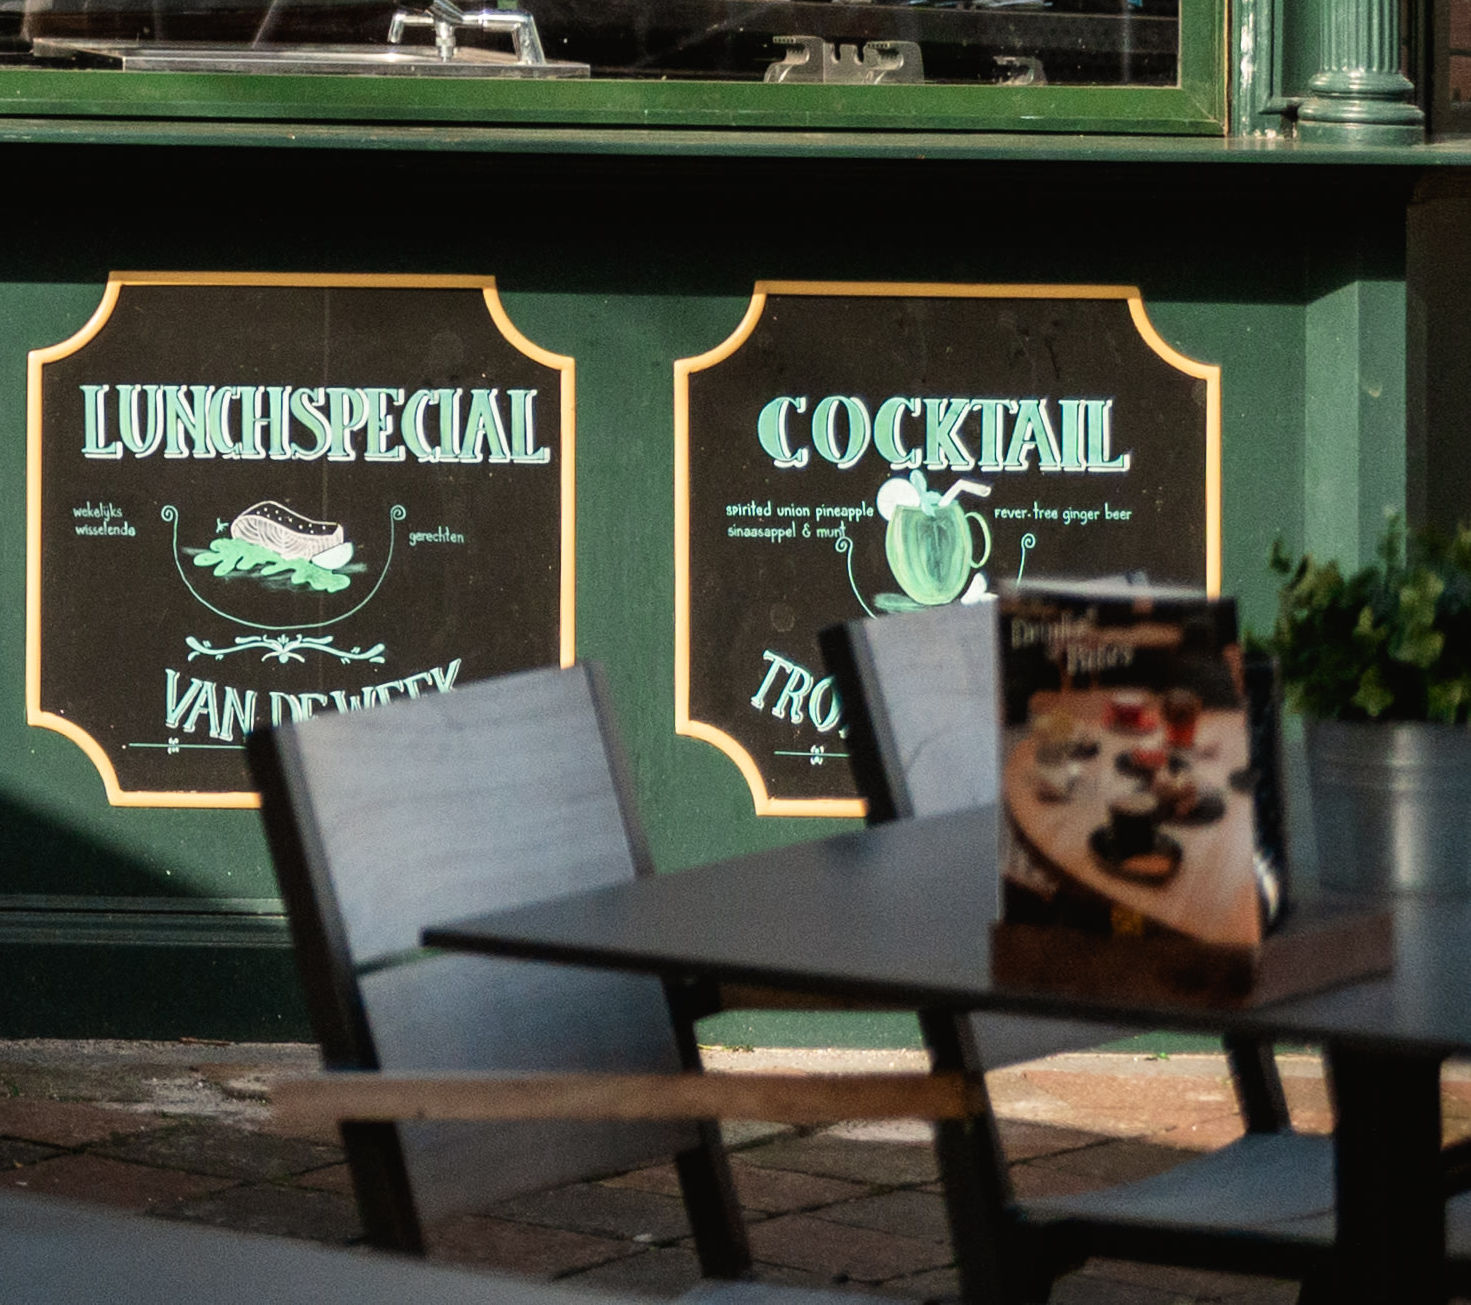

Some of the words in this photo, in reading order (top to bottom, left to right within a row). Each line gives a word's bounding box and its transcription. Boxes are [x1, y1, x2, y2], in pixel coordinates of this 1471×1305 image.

[79, 383, 550, 464] LUNCHSPECIAL
[756, 394, 1133, 473] COCKTAIL
[725, 499, 772, 517] spirited
[777, 503, 810, 517] union
[815, 500, 875, 522] pineapple
[1062, 507, 1101, 525] ginger
[1104, 502, 1132, 520] beer
[409, 525, 465, 547] gerechten
[727, 520, 797, 543] sinaasappel
[802, 522, 811, 538] &
[816, 520, 846, 538] munt
[165, 667, 257, 741] VAN
